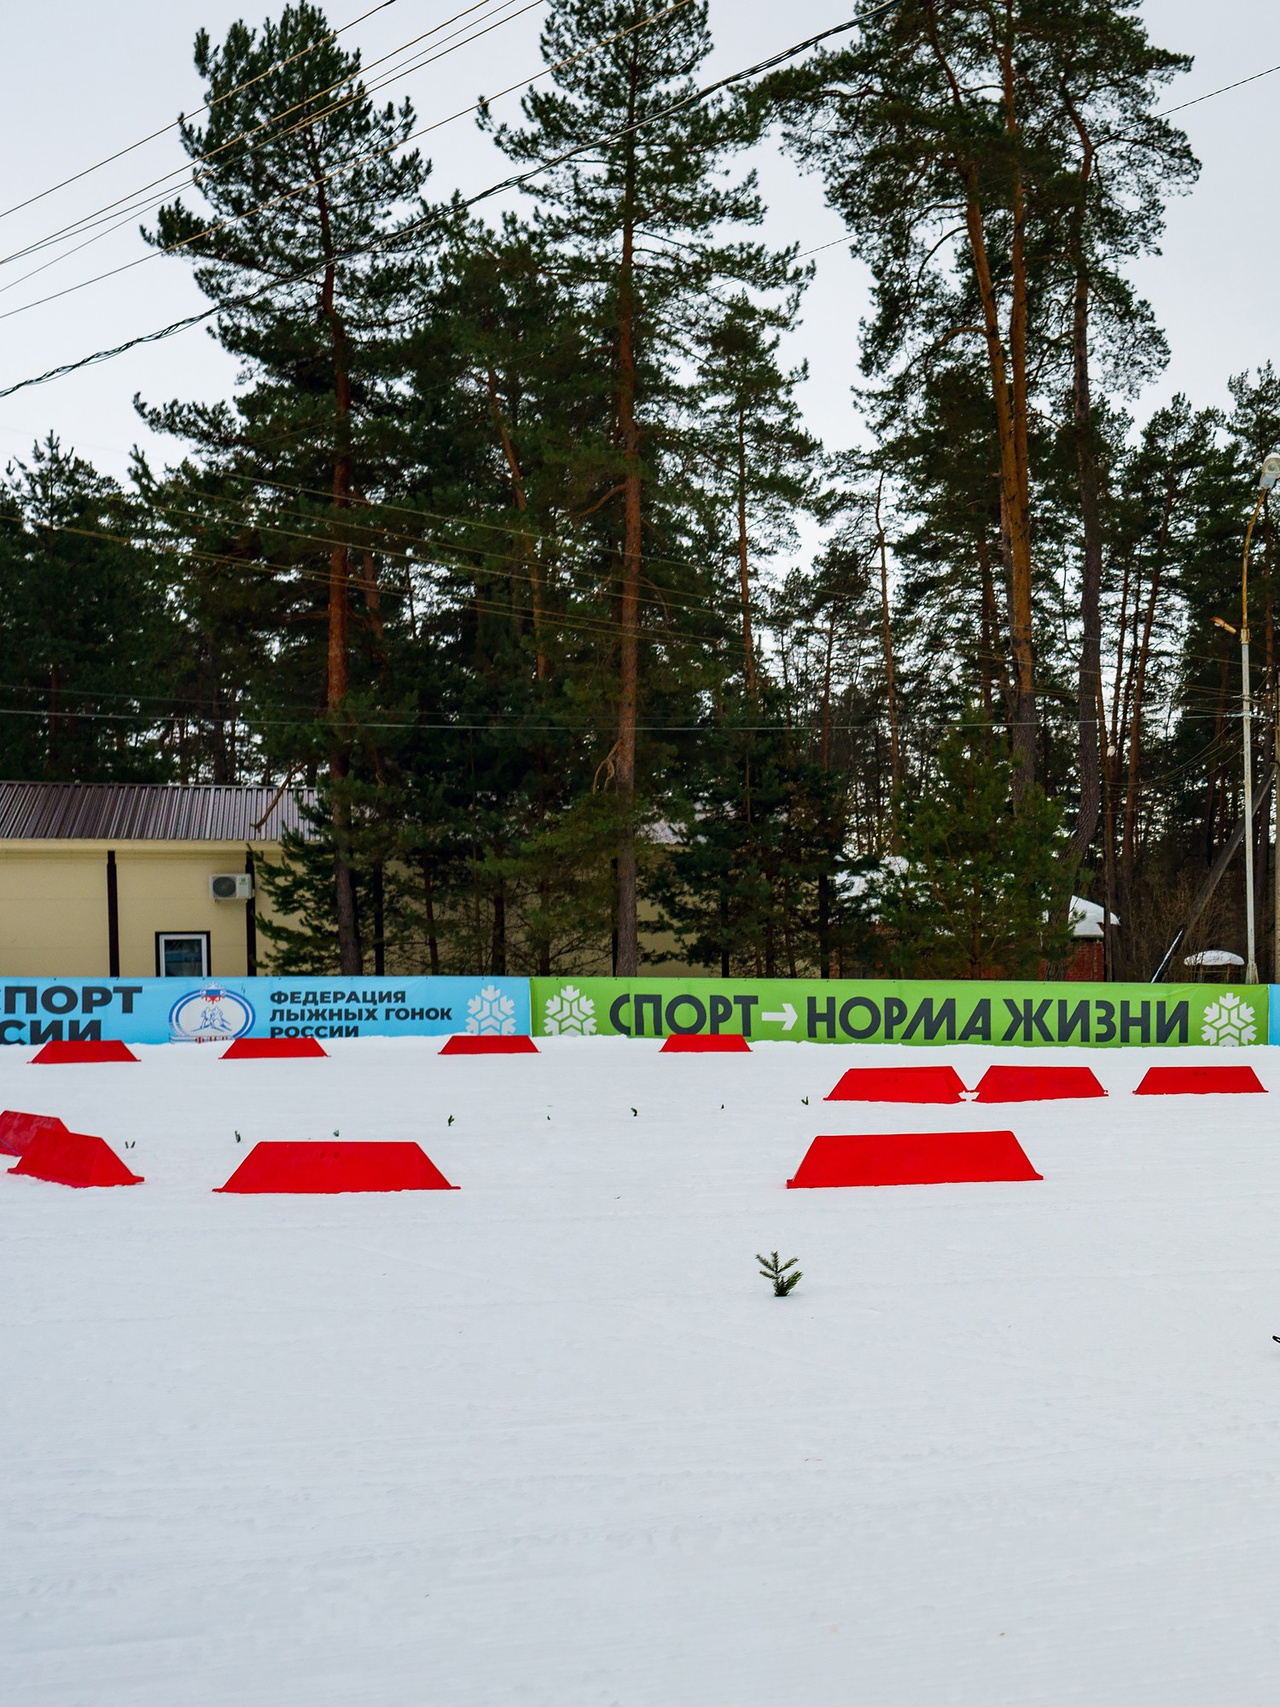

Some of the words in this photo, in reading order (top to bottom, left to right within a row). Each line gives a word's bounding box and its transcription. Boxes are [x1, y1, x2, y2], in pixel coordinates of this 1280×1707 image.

[0, 986, 143, 1014] ПОРТ
[270, 991, 406, 1005] ФЕДЕРАЦИЯ
[270, 1008, 378, 1022] ЛЫЖНЫХ
[385, 1008, 452, 1020] ГОНОК
[609, 993, 759, 1037] СПОРТ
[806, 996, 992, 1041] НОРМА
[1000, 998, 1190, 1044] ЖИЗНИ
[270, 1025, 359, 1038] РОССИИ
